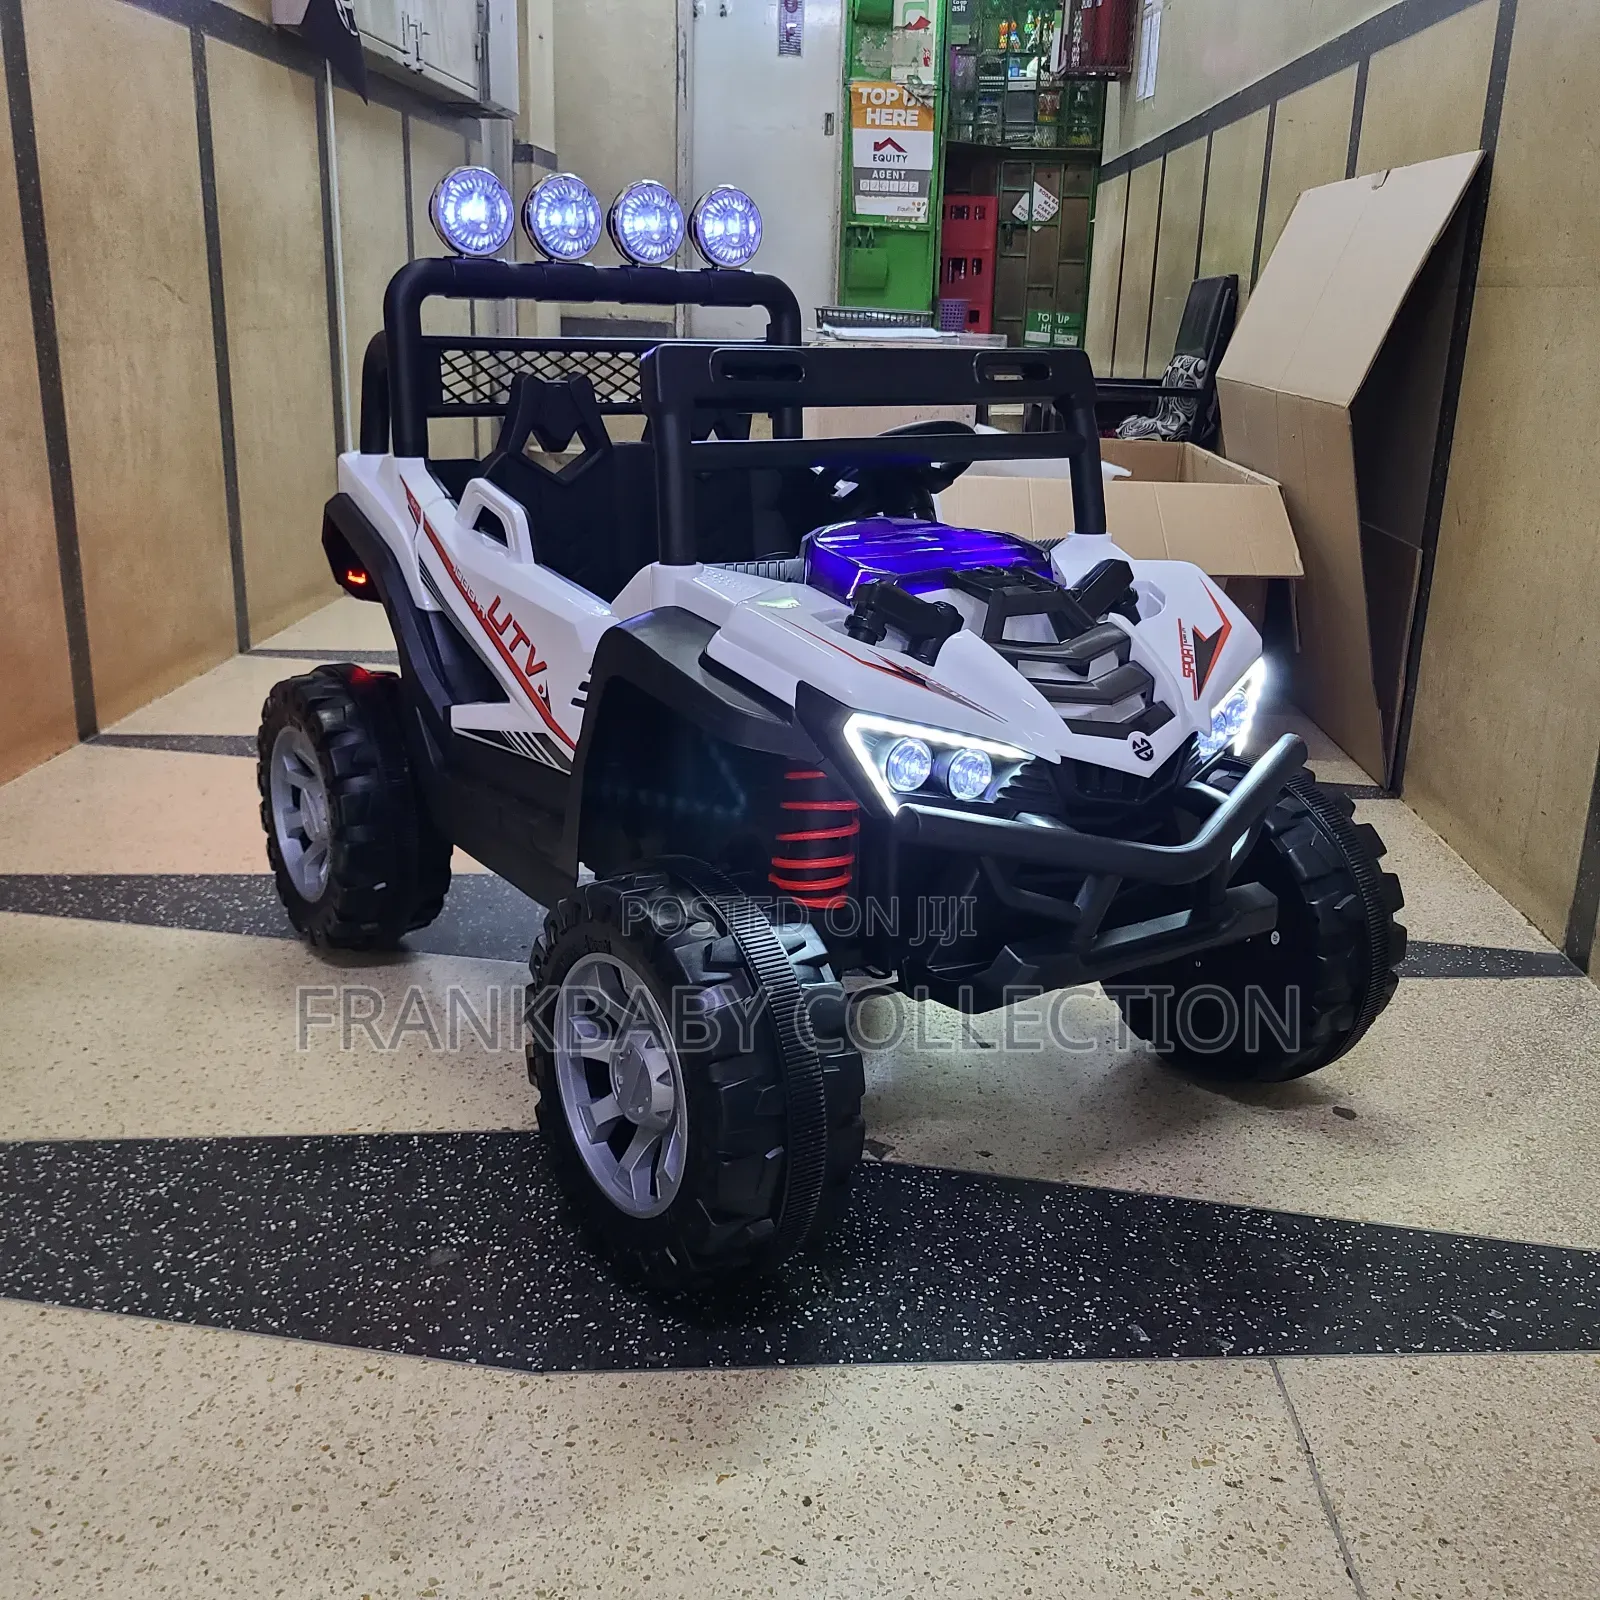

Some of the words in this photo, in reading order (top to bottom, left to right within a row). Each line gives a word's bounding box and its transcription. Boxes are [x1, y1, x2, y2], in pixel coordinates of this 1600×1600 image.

[858, 87, 899, 105] TOP
[866, 108, 919, 127] HERE
[872, 153, 908, 163] EQUITY
[872, 170, 906, 180] AGENT
[1057, 313, 1071, 324] UP
[486, 594, 548, 677] UTV
